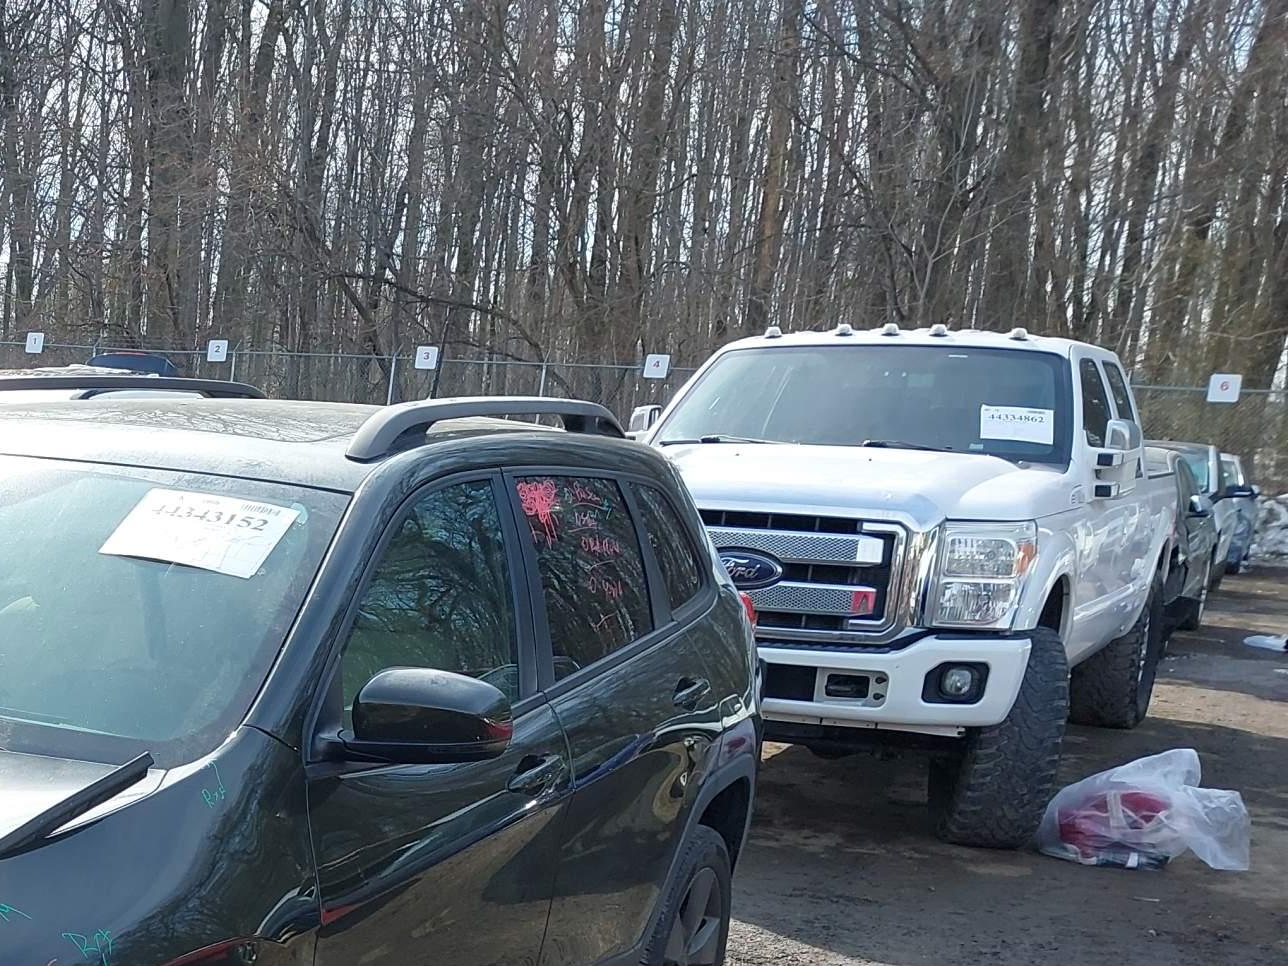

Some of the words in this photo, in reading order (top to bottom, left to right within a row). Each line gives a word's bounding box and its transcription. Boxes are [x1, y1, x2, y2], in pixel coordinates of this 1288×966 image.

[214, 345, 221, 353] 2
[423, 352, 430, 360] 3
[652, 360, 661, 369] 4
[1220, 380, 1230, 391] 6
[151, 503, 270, 532] 44343152
